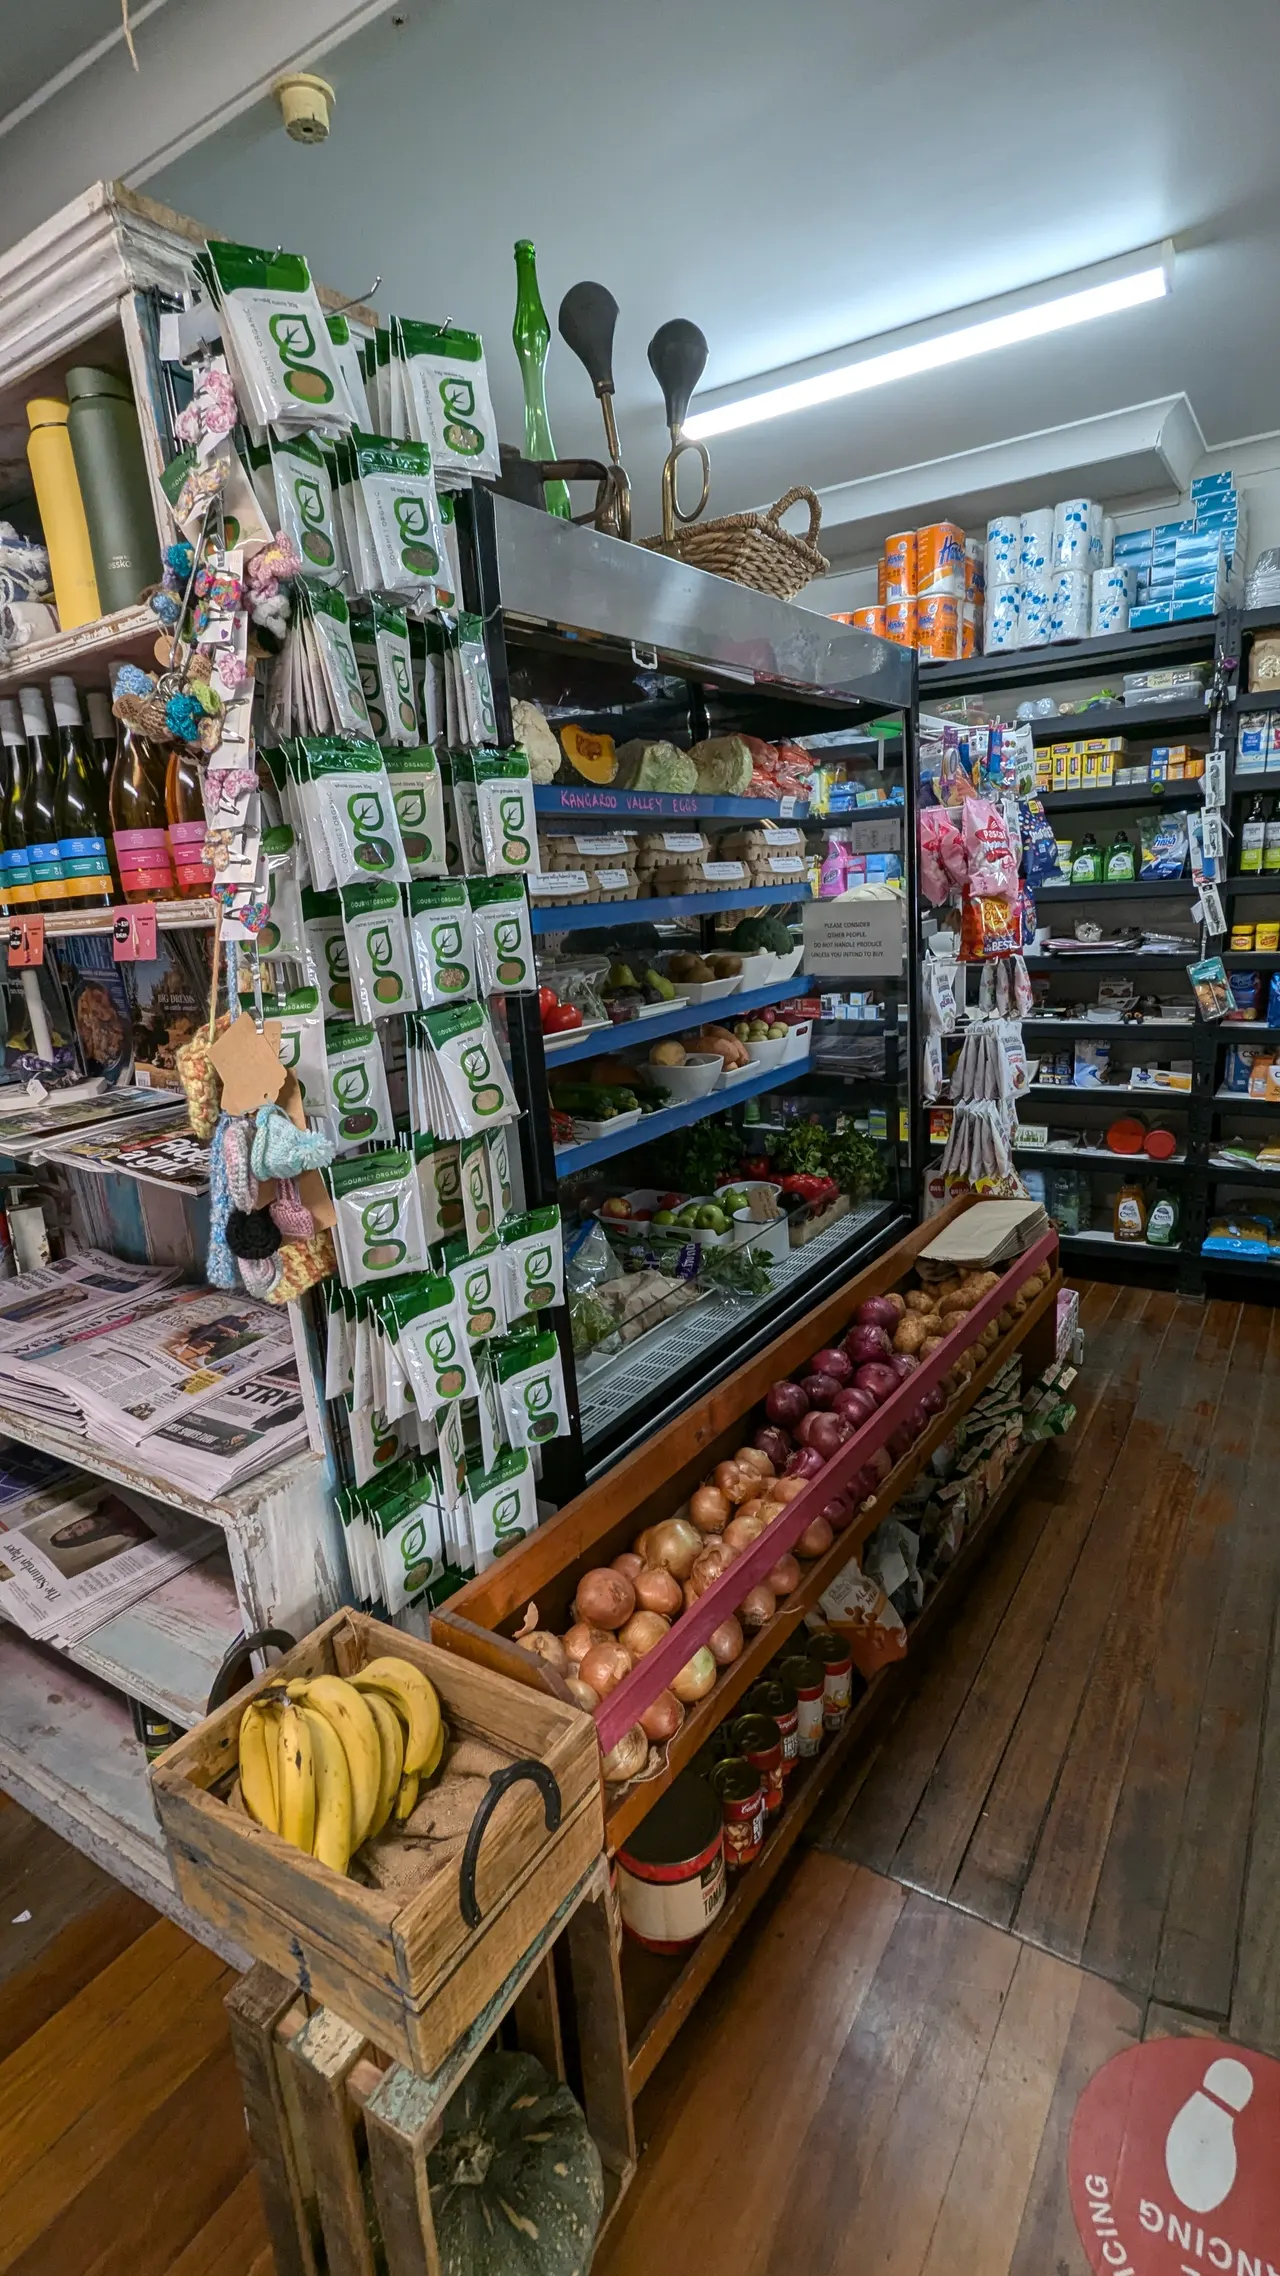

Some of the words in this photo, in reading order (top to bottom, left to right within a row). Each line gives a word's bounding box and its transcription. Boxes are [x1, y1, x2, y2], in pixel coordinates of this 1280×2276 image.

[243, 308, 263, 348] ORGANIC
[373, 491, 388, 527] ORGANIC
[383, 529, 397, 566] GOURMET
[404, 760, 431, 769] ORGANIC
[327, 791, 341, 828] ORGANIC
[560, 789, 618, 809] KANGAROO
[626, 796, 663, 812] VALLEY
[672, 797, 698, 813] EGGS
[261, 844, 287, 853] RGANIC
[337, 828, 349, 865] GOURMET
[1154, 833, 1176, 847] finish
[372, 896, 395, 907] ORGANIC
[417, 897, 440, 905] GOURMET
[440, 895, 462, 904] ORGANIC
[992, 939, 1014, 952] BEST
[157, 994, 169, 1003] BIG
[170, 994, 196, 1003] DREAMS
[282, 1003, 311, 1012] ORGANIC
[437, 1024, 460, 1036] GOURMET
[460, 1017, 483, 1030] ORGANIC
[342, 1035, 370, 1047] ORGANIC
[117, 1150, 149, 1162] a
[343, 1174, 374, 1186] GOURMET
[374, 1168, 405, 1183] ORGANIC
[2, 1318, 102, 1355] WEEKEND
[479, 1476, 500, 1491] GOURMET
[500, 1463, 525, 1480] ORGANIC
[3, 1543, 24, 1563] Paper
[19, 1553, 50, 1593] Saturday
[44, 1587, 62, 1603] The
